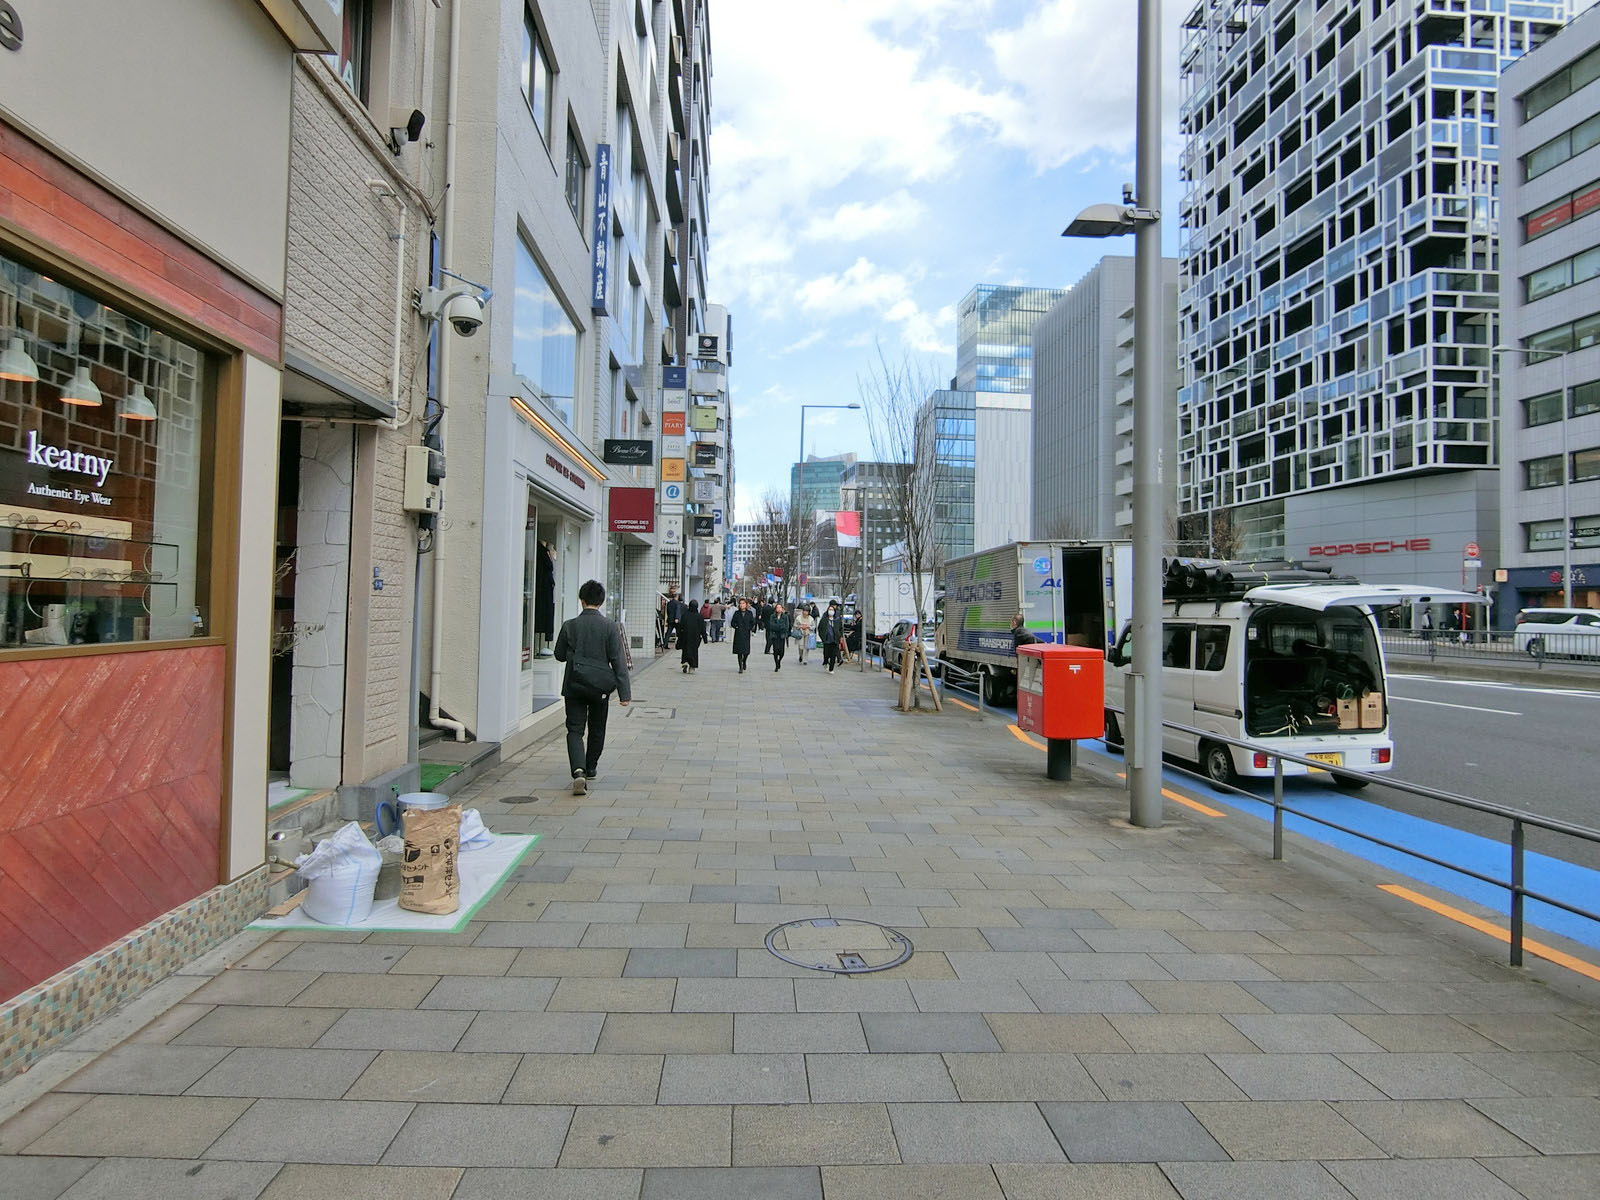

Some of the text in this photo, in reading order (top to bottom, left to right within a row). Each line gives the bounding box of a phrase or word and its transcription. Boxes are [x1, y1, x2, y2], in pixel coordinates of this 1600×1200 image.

[28, 430, 113, 487] kearny
[27, 482, 112, 506] Authentic Eye Wear
[1309, 538, 1431, 557] PORSCHE
[955, 581, 1002, 603] ACROSS
[978, 637, 1013, 650] TRANSPORT
